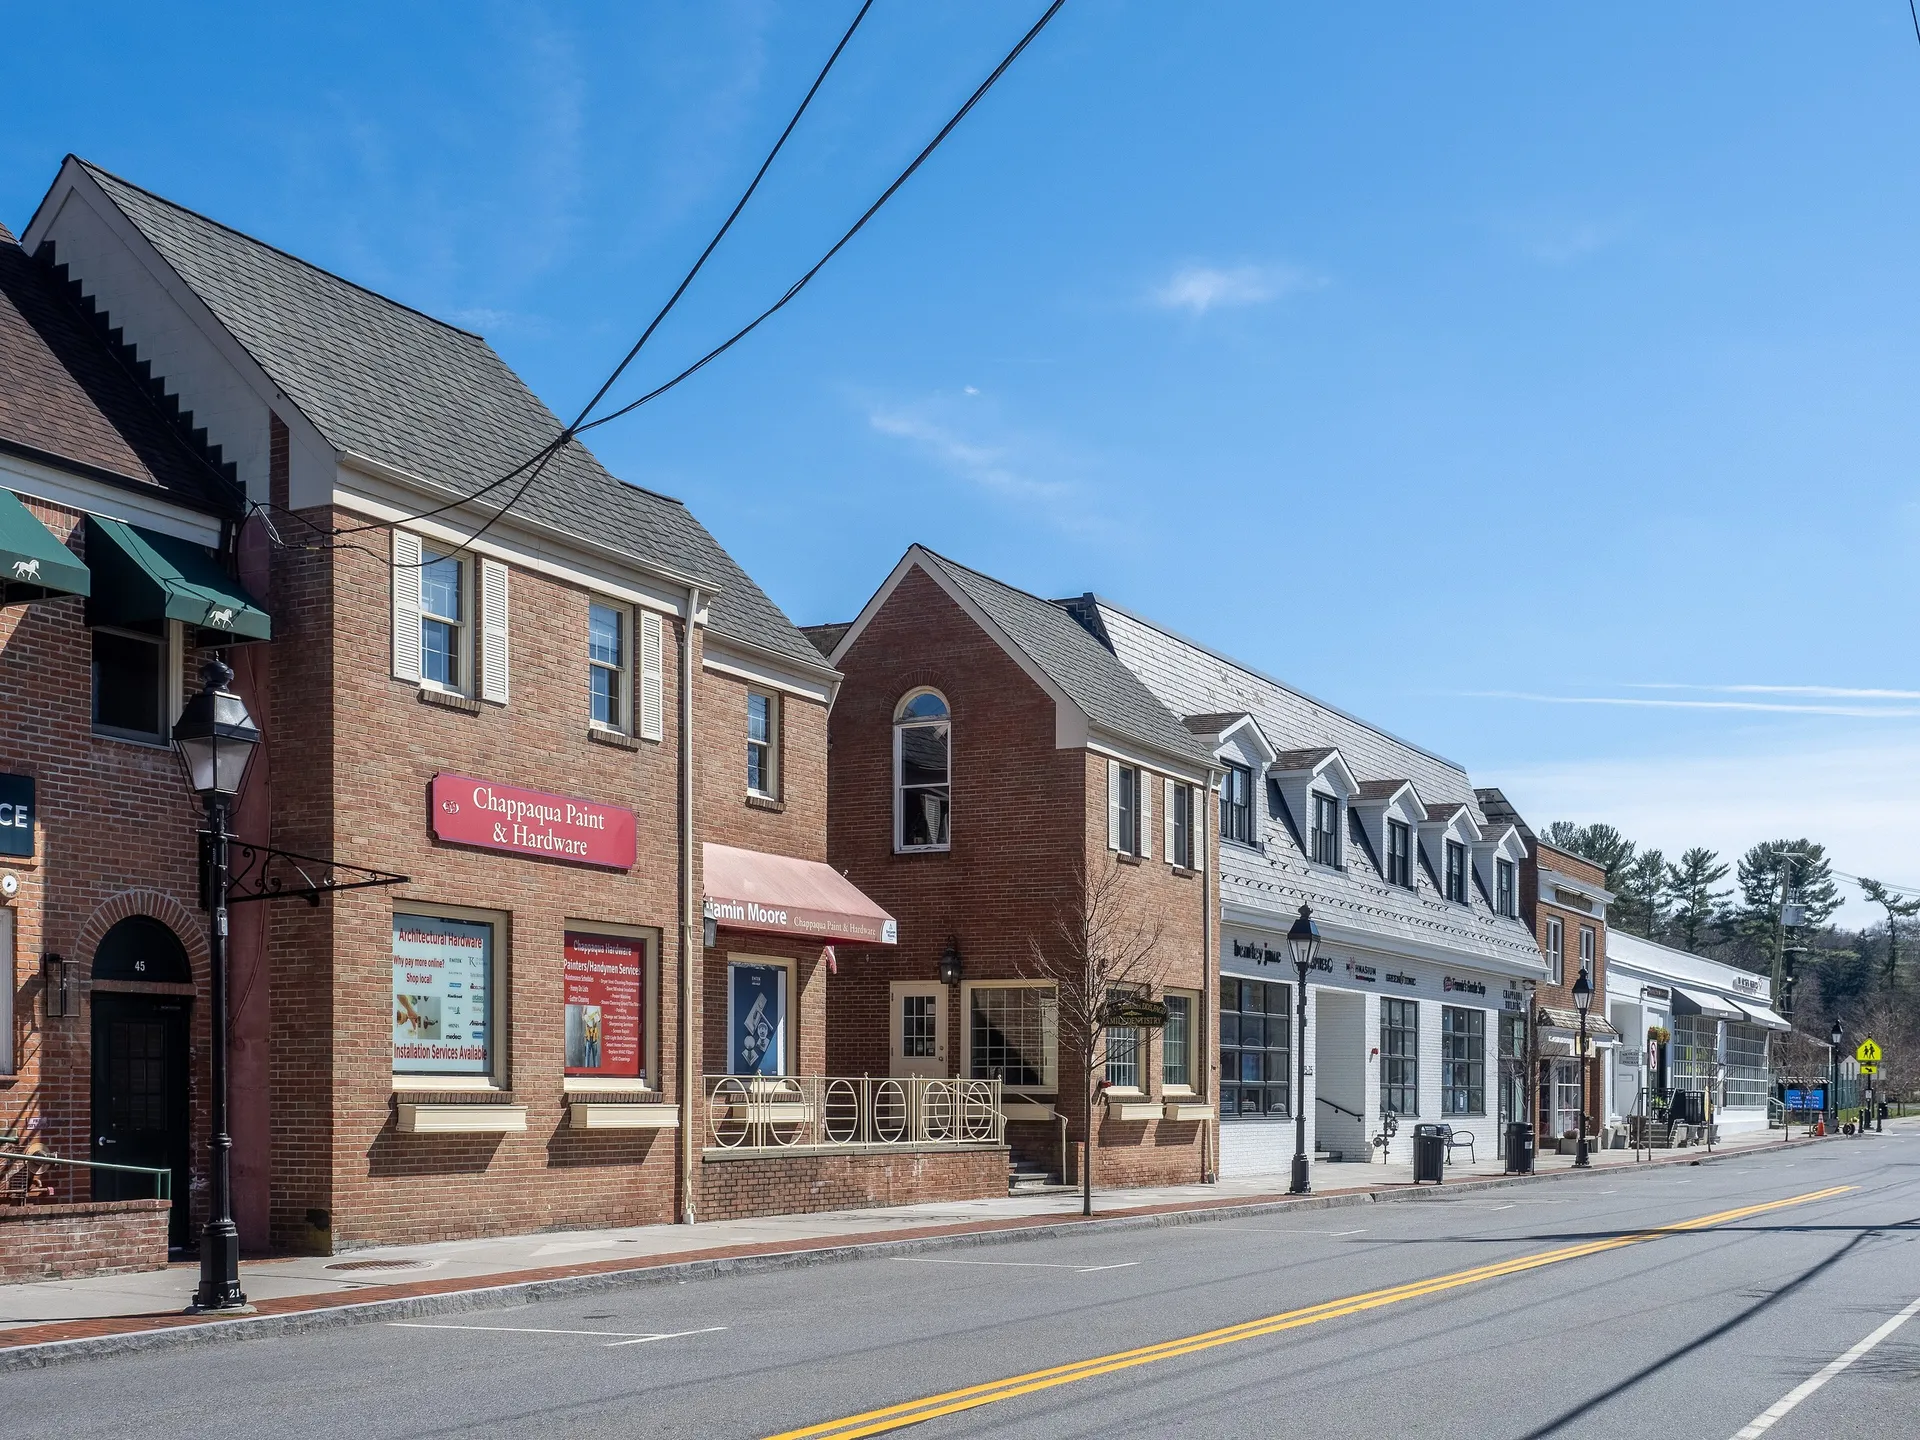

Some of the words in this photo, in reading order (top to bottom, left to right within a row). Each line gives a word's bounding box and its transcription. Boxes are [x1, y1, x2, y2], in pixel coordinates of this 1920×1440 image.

[473, 787, 561, 825] Chappaqua
[566, 804, 605, 830] Paint
[493, 822, 508, 843] &
[513, 824, 588, 855] Hardware
[748, 903, 787, 925] Moore
[793, 917, 826, 931] Chappaqua
[827, 920, 842, 931] Paint
[843, 924, 849, 932] &
[849, 923, 876, 936] Hardware
[399, 928, 447, 945] Architectural
[448, 931, 482, 948] Hardware
[573, 940, 605, 956] Chappaqua
[605, 943, 632, 956] Hardware
[134, 960, 146, 971] 45
[393, 955, 404, 968] Why
[405, 957, 414, 969] pay
[414, 959, 427, 967] more
[428, 958, 445, 969] online?
[564, 959, 619, 976] Painters/Handymen
[619, 963, 641, 976] Services
[406, 972, 419, 985] Shop
[419, 974, 433, 984] local!
[394, 1043, 430, 1059] Installation
[431, 1044, 458, 1060] Services
[459, 1045, 488, 1060] Available
[229, 1288, 240, 1298] 21
